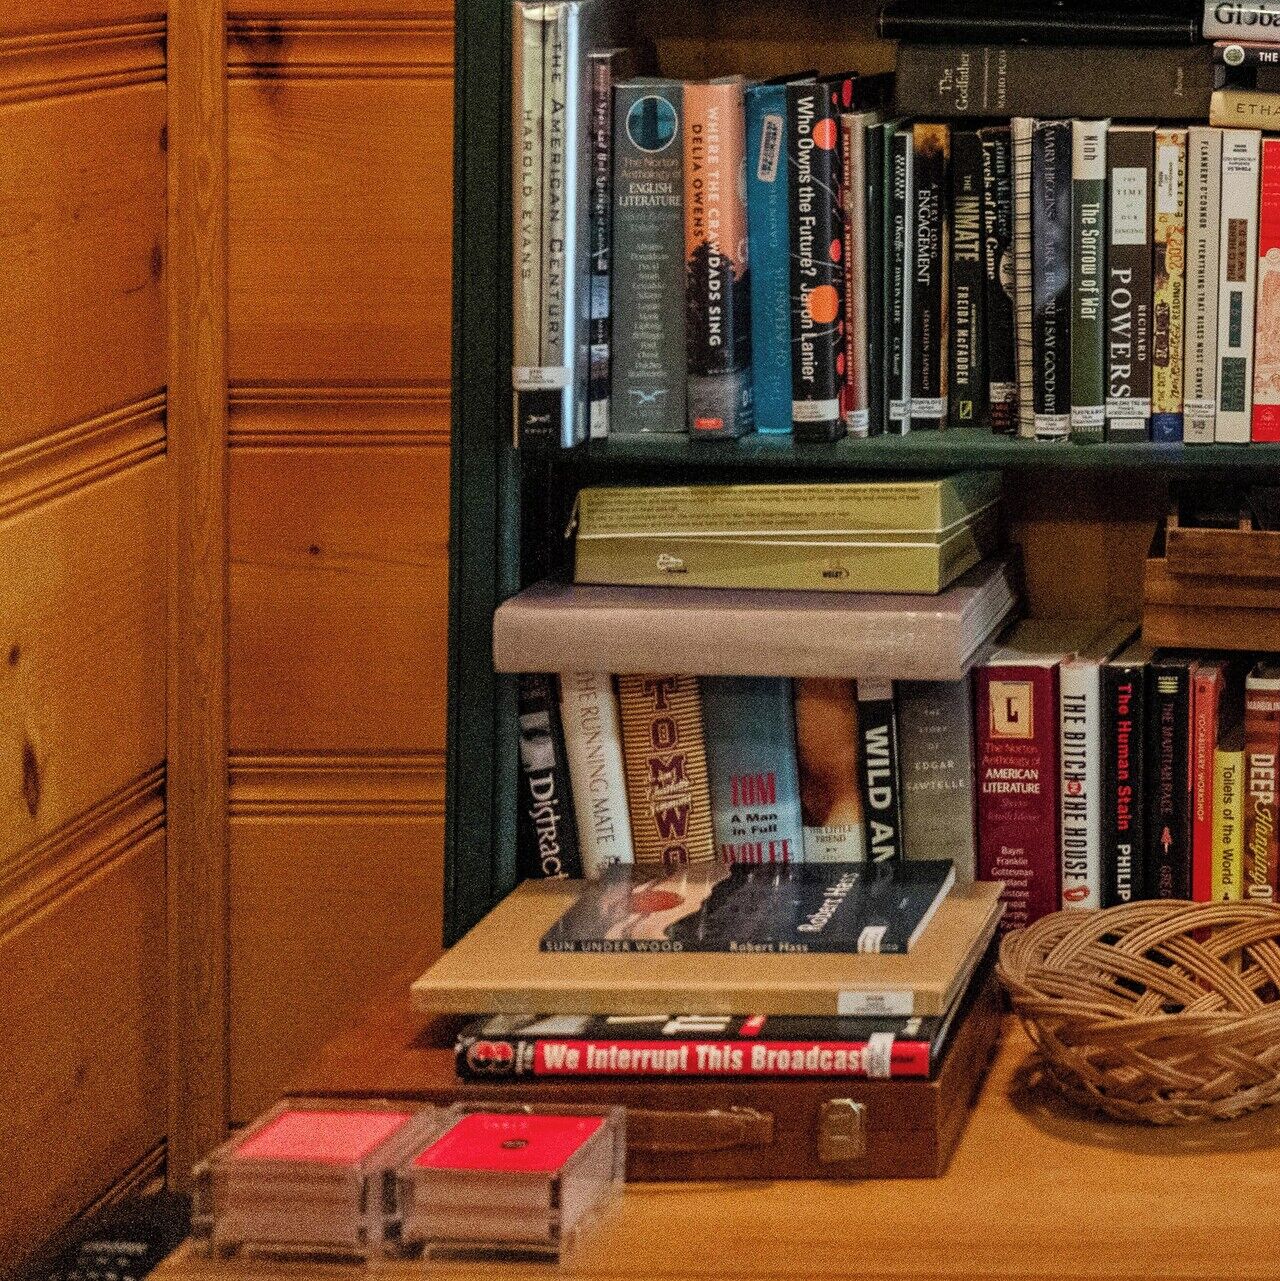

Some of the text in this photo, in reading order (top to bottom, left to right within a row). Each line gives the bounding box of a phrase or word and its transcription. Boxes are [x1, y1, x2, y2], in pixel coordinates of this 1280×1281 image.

[1258, 51, 1278, 63] THE
[629, 183, 672, 194] ENGLISH
[796, 96, 818, 383] Who Owns the Future? Lanier
[954, 195, 980, 262] INMATE
[956, 287, 969, 384] FREIDA McFADDEN
[1110, 268, 1131, 398] POWERS
[864, 725, 892, 809] WILD
[986, 769, 1039, 780] AMERICAN
[1116, 683, 1133, 831] The Human Stain
[982, 782, 1040, 793] LITERATURE
[1063, 694, 1087, 881] THE BITCH THE HOUSE
[743, 825, 777, 836] Full
[745, 813, 778, 823] Man
[1116, 843, 1132, 901] PHILIP
[637, 941, 683, 952] WOOD
[543, 1046, 580, 1070] We
[586, 1046, 687, 1071] Interrupt
[695, 1046, 743, 1070] This
